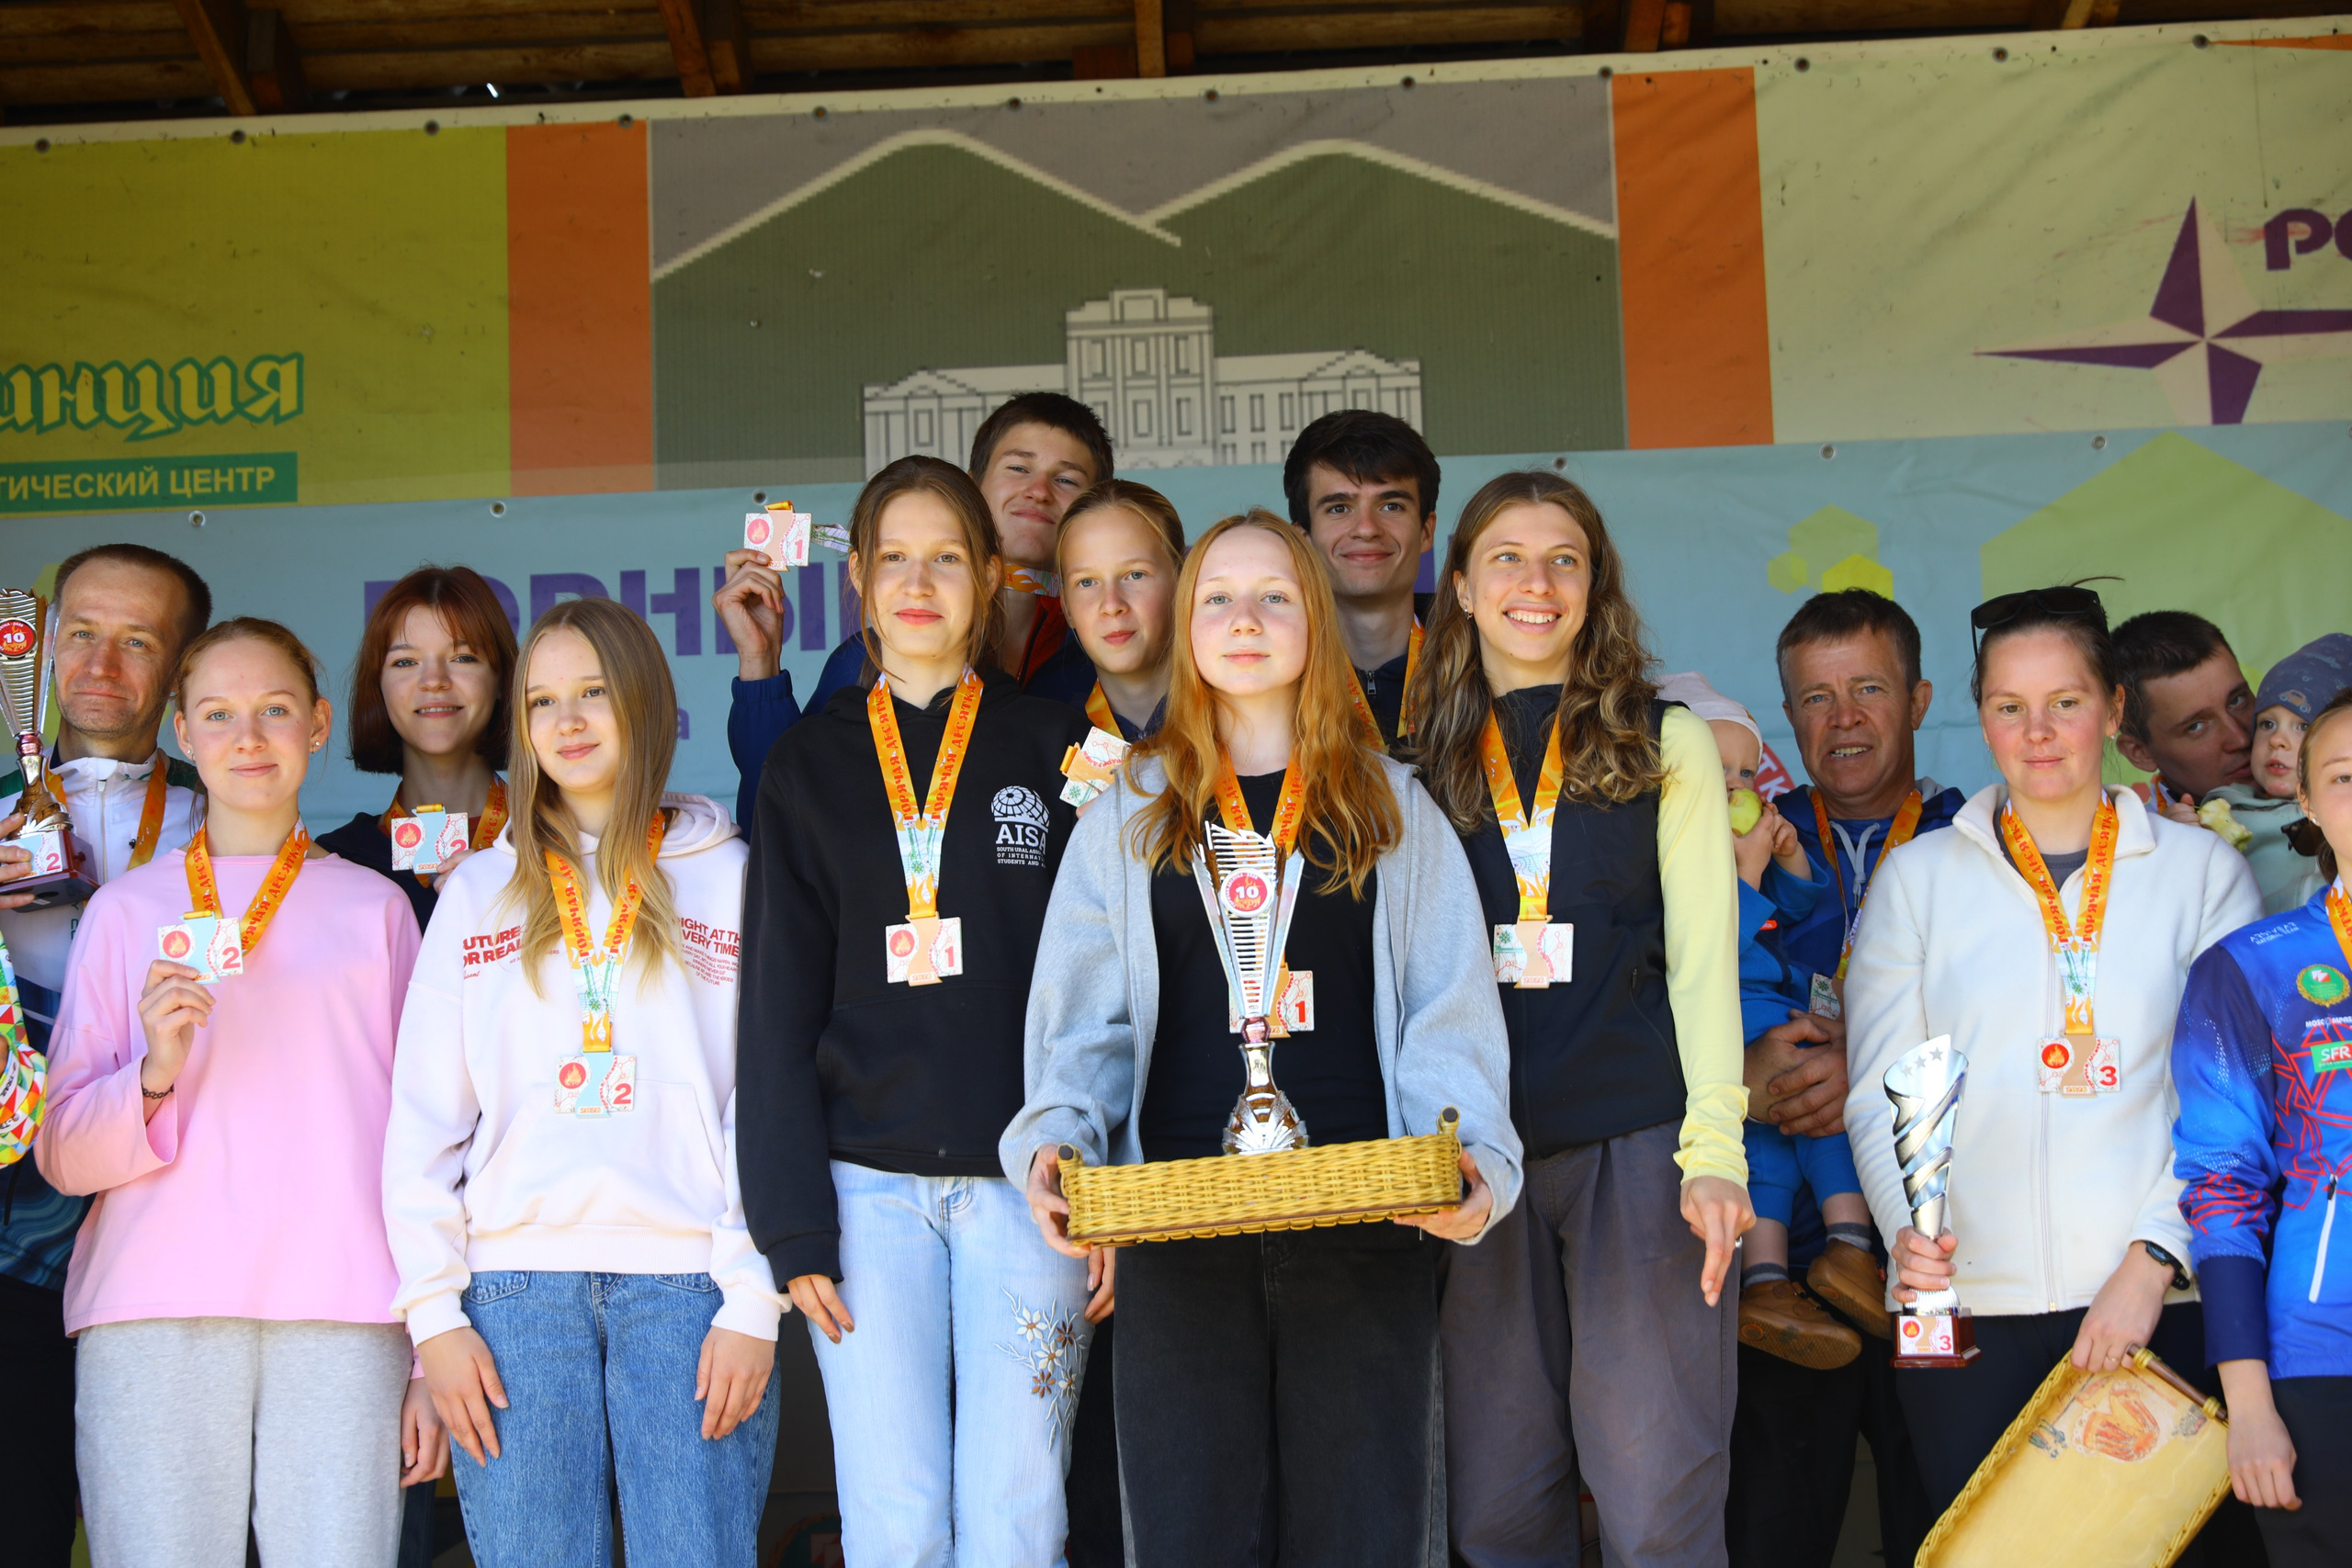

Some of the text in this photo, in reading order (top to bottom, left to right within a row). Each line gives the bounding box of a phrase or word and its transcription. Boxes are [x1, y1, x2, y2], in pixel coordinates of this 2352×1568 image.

[170, 467, 276, 498] ЦЕНТР
[795, 539, 803, 559] 1
[3, 633, 25, 643] 10
[875, 690, 913, 820] ГОРЯЧАЯ ДЕСЯТКА
[932, 685, 976, 819] ГОРЯЧАЯ ДЕСЯТКА
[1277, 803, 1296, 847] РЯЧАЯ
[450, 839, 467, 855] 2
[995, 824, 1046, 855] AISA
[46, 852, 61, 872] 2
[2007, 816, 2069, 942] ГОРЯЧАЯ ДЕСЯТКА
[2082, 807, 2113, 942] ГОРЯЧАЯ ДЕСЯТКА
[242, 842, 302, 950] РЯЧАЯ ДЕСЯТКА
[1236, 886, 1260, 899] 10
[565, 886, 589, 957] ГОРЯЧАЯ
[679, 918, 708, 935] IGHT
[710, 929, 725, 942] AT
[463, 925, 521, 951] UTURE
[682, 930, 711, 949] VERY
[714, 941, 740, 957] TIME
[222, 946, 241, 970] 2
[944, 945, 955, 967] 1
[1295, 1000, 1306, 1023] 1
[2321, 1045, 2351, 1062] SFR
[2099, 1065, 2118, 1086] 3
[613, 1083, 632, 1105] 2
[1939, 1335, 1951, 1351] 3
